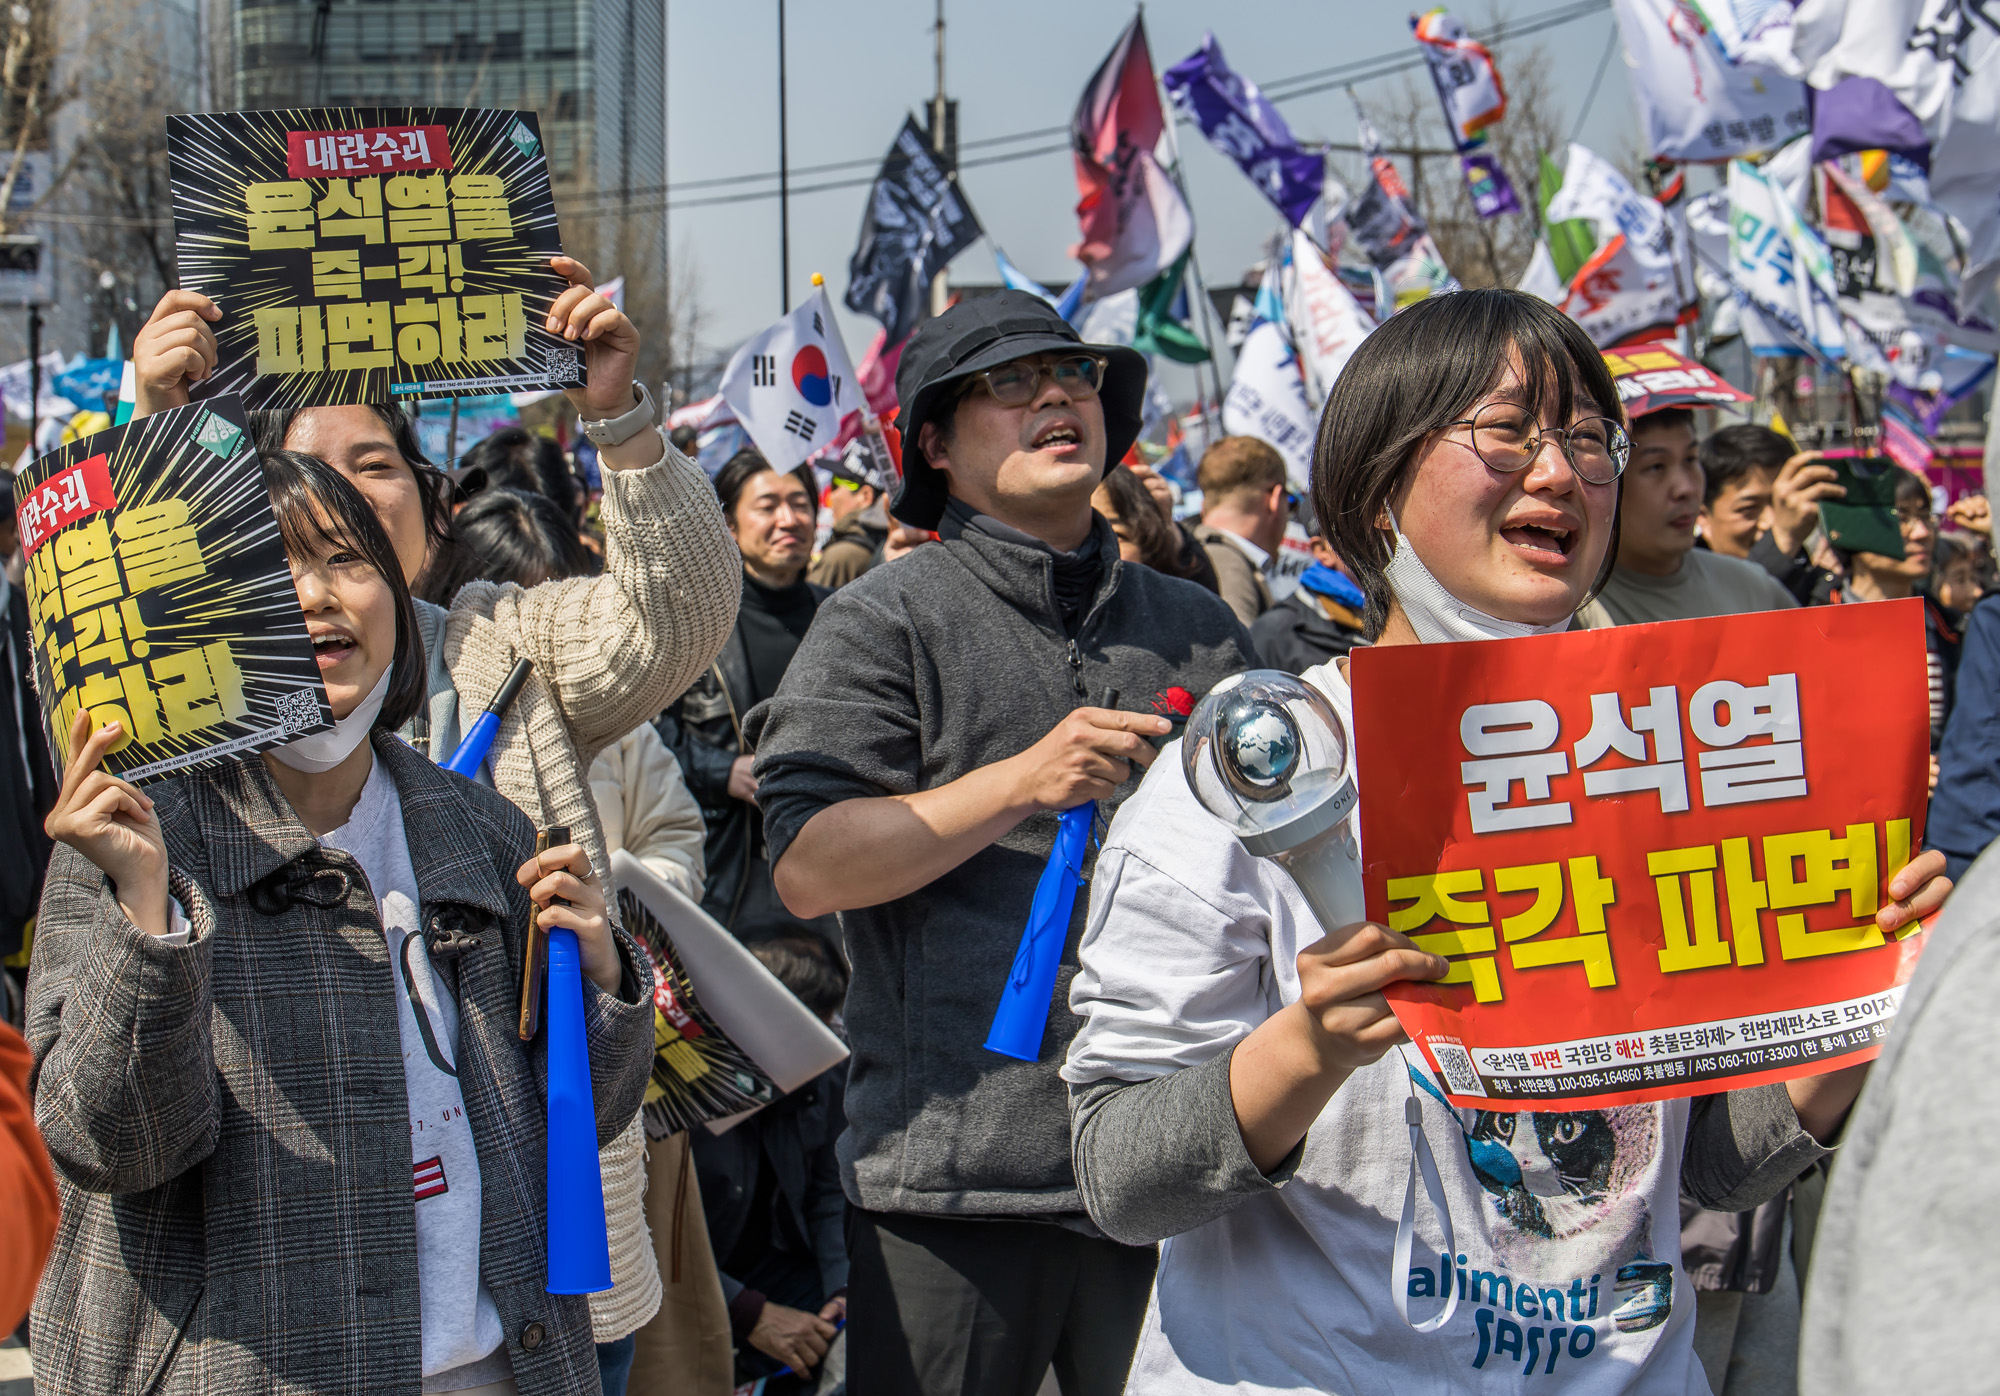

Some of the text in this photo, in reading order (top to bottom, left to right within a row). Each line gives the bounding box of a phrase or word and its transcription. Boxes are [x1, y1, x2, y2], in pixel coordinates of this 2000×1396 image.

[305, 129, 431, 171] 내란수괴
[245, 173, 514, 251] 윤석열을
[311, 243, 467, 299] 즉-각!
[253, 292, 528, 376] 파면하라
[20, 468, 91, 548] 내란수괴
[1459, 672, 1808, 834] 윤석열
[1386, 854, 1617, 1004] 즉각
[1646, 817, 1922, 974] 파면!
[1482, 1052, 1531, 1072] <윤석열
[1529, 1048, 1563, 1070] 파면
[1564, 1042, 1613, 1067] 국힘당
[1614, 1037, 1646, 1059] 해산
[1649, 1025, 1736, 1056] 촛불문화제>
[1738, 1010, 1842, 1042] 헌법재판소로
[1491, 1078, 1514, 1093] 후원
[1518, 1077, 1557, 1093] 신한은행
[1557, 1067, 1642, 1091] 100-036-164860
[1643, 1060, 1686, 1081] 촛불행동
[1695, 1057, 1717, 1073] ARS
[1718, 1043, 1799, 1070] 060-707-3300
[1800, 1040, 1819, 1058] (한
[1820, 1034, 1847, 1052] 통에
[1848, 1027, 1871, 1045] 1만
[1407, 1253, 1601, 1323] alimenti
[1472, 1308, 1597, 1376] SASSO
